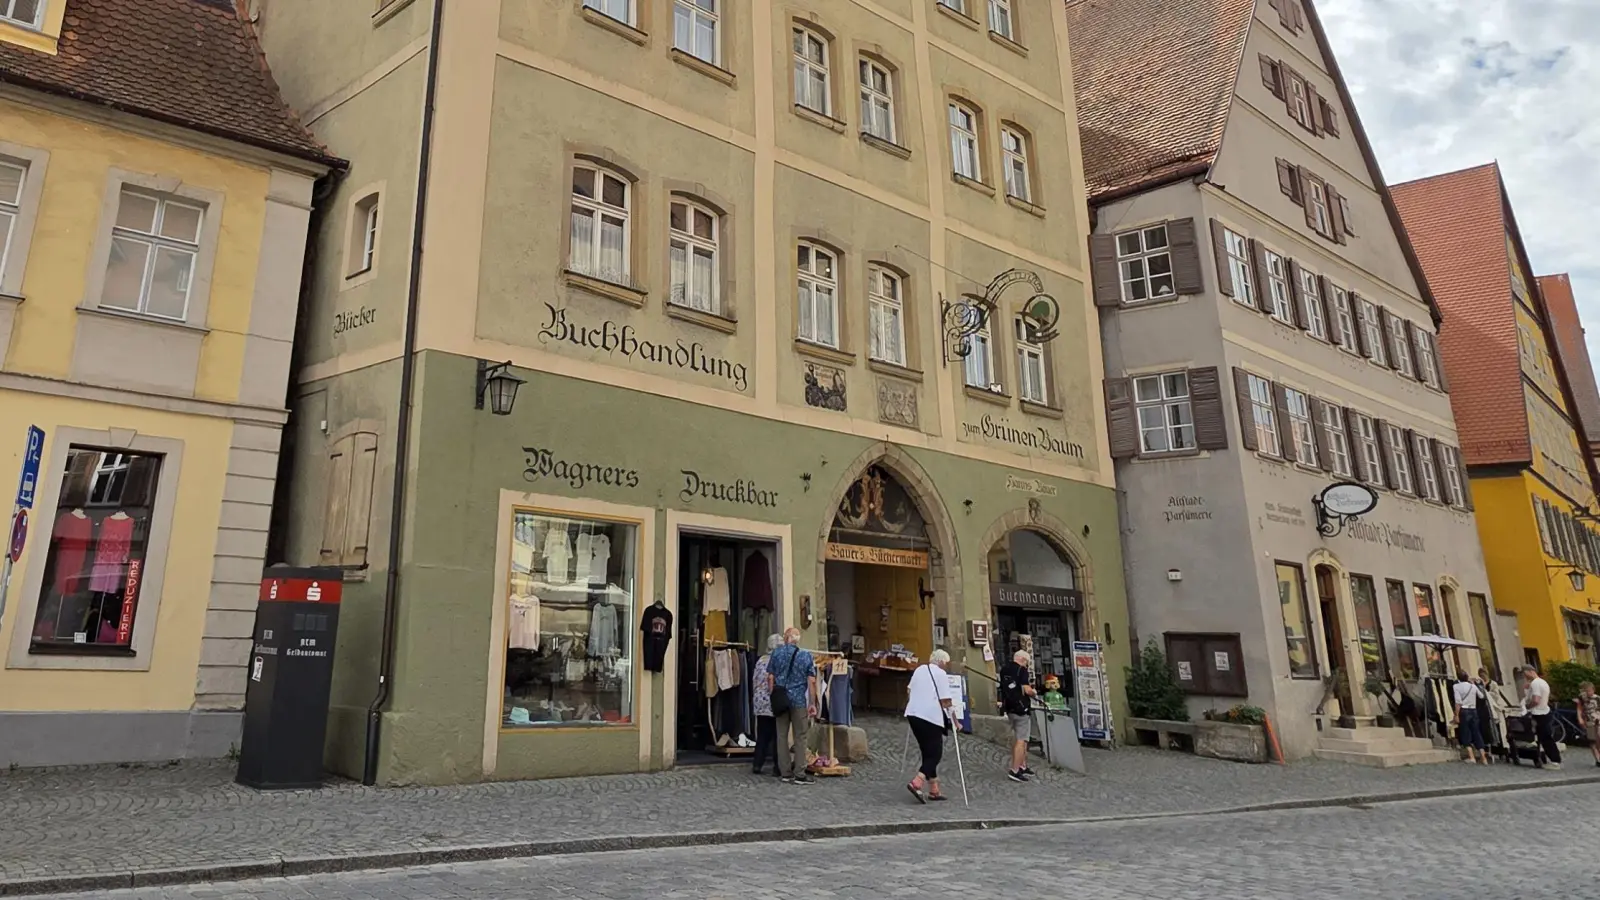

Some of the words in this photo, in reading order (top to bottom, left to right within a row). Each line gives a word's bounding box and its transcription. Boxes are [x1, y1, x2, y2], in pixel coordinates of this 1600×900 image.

[333, 305, 377, 339] Bücher
[537, 300, 748, 391] Buchhandlung
[962, 422, 980, 436] zum
[980, 413, 1038, 449] Grünen
[1038, 427, 1084, 459] Baum
[521, 446, 640, 489] Wagners
[679, 468, 779, 508] Druckbar
[119, 561, 140, 640] REDUZIERT
[999, 588, 1076, 609] Buchhandlung
